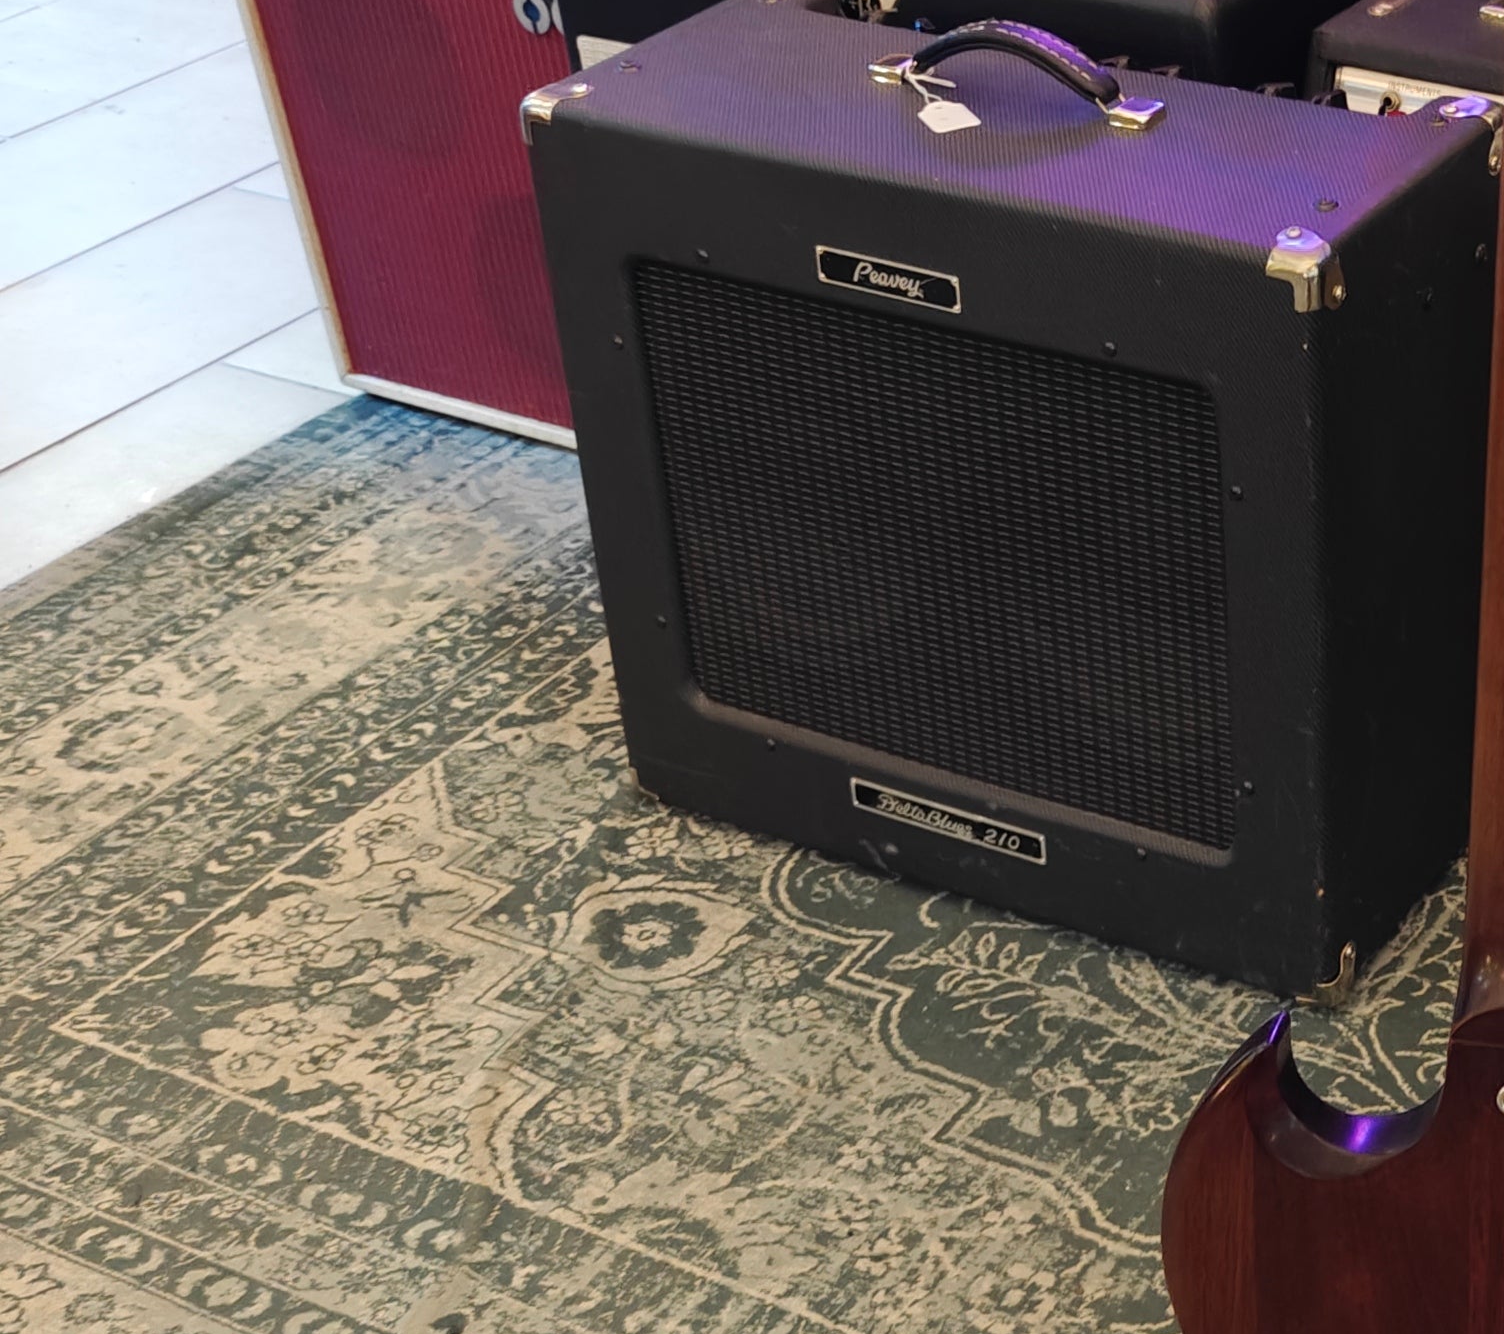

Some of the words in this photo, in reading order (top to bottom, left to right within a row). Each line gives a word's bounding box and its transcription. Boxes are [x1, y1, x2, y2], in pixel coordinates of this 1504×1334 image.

[1388, 80, 1442, 98] INSTRUMENTS
[853, 261, 924, 299] Peavey
[983, 828, 1021, 851] 210
